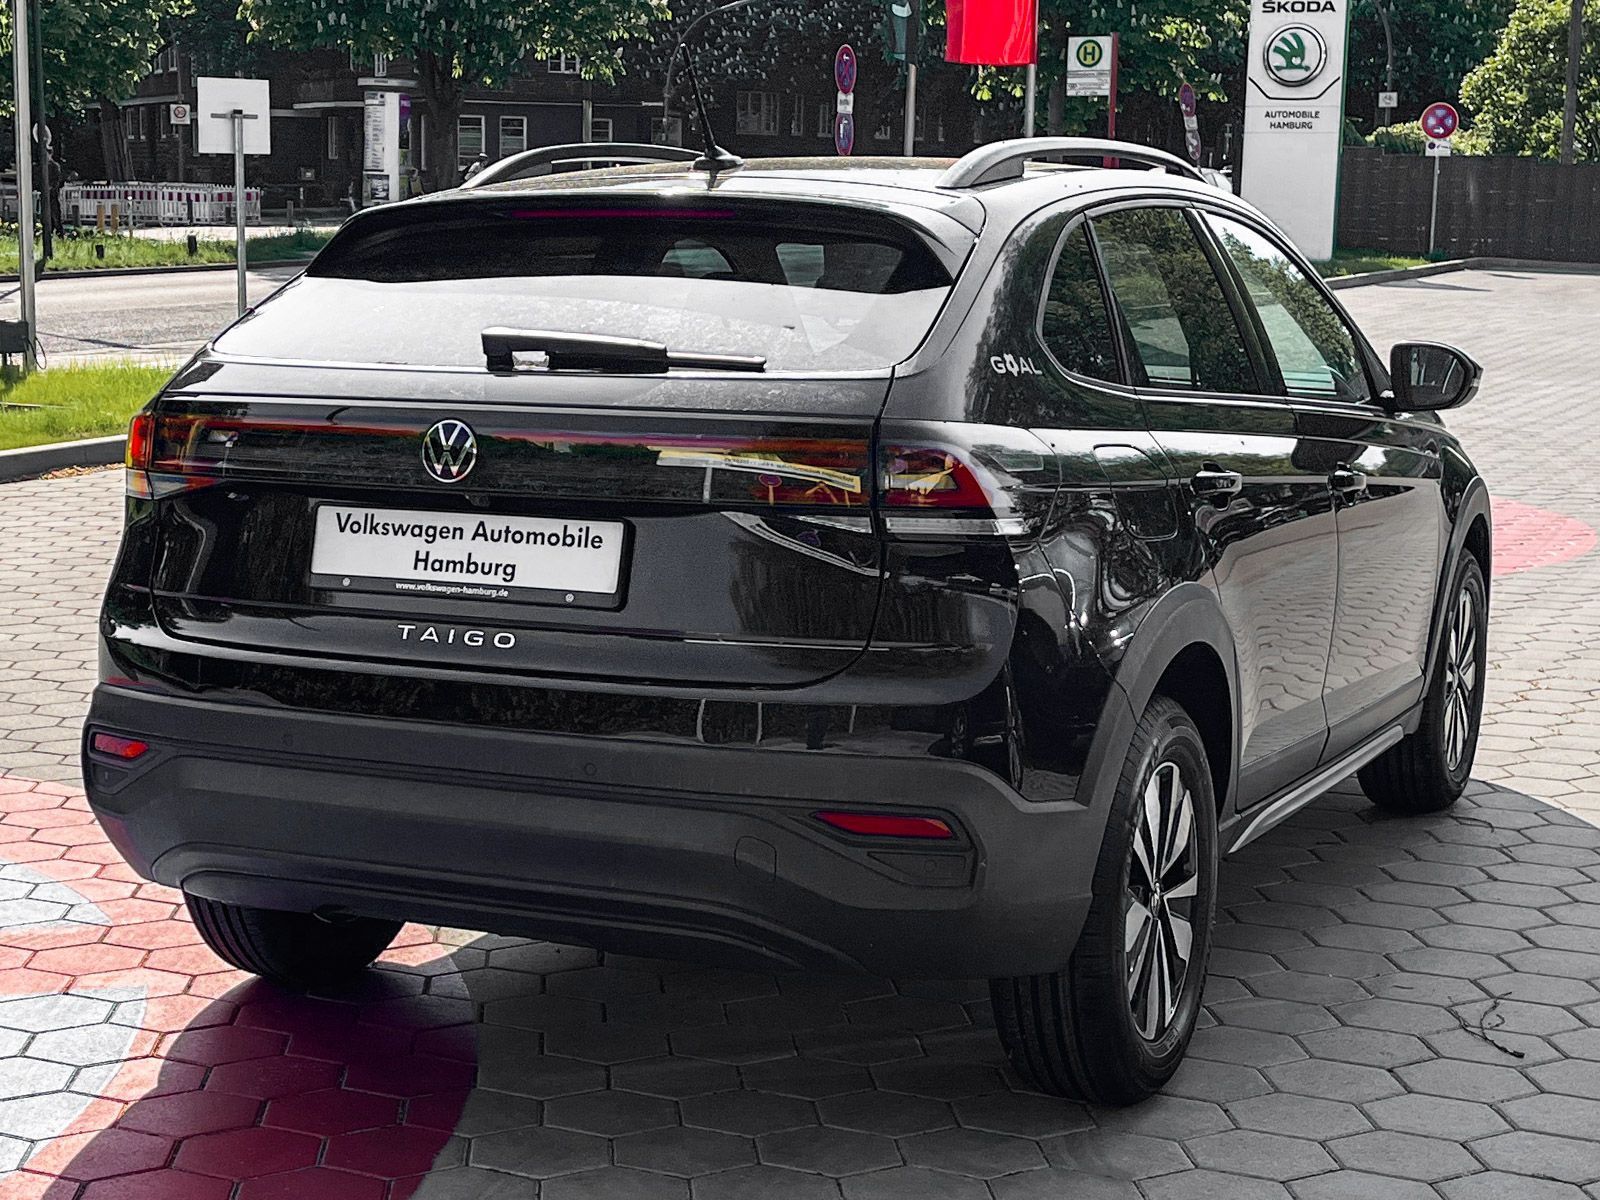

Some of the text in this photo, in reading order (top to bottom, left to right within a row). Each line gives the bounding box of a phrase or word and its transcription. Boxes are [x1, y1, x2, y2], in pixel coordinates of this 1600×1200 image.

[1083, 45, 1096, 61] H
[1264, 111, 1320, 119] AUTOMOBILE
[1269, 121, 1313, 130] HAMBURG
[423, 420, 476, 481] VW
[336, 512, 604, 549] Volkswagen Automobile
[413, 550, 516, 582] Hamburg
[395, 582, 508, 598] www.volkswagen-hamburg.de
[397, 624, 516, 649] TAIGO
